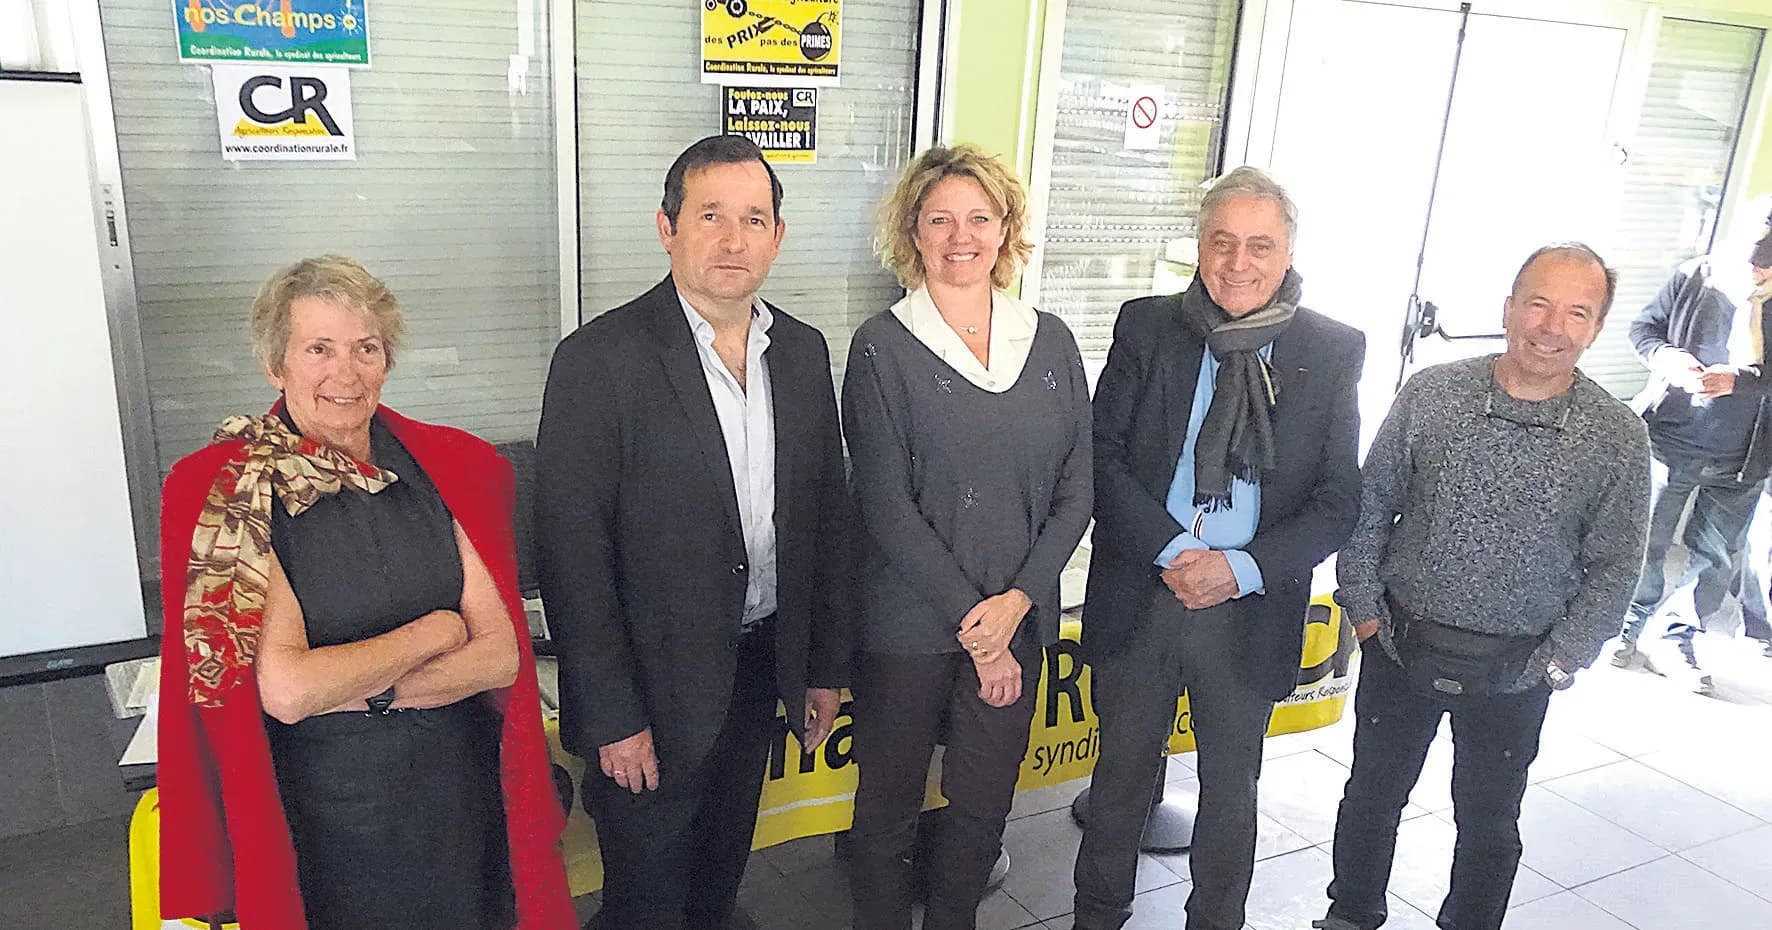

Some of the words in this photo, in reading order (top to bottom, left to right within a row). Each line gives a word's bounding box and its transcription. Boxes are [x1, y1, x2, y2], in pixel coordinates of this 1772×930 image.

[184, 7, 229, 24] nos
[233, 4, 336, 33] Champs
[705, 35, 723, 44] des
[727, 22, 764, 49] PRIX
[760, 38, 778, 47] pas
[780, 36, 798, 47] des
[801, 34, 831, 49] PRIMES
[728, 88, 788, 100] Foutez-nous
[796, 91, 813, 104] CR
[238, 75, 345, 137] CR
[728, 100, 746, 115] LA
[750, 101, 788, 118] PAIX,
[727, 117, 811, 132] Laissez-nous
[225, 143, 348, 154] www.coordinationrurale.fr
[727, 131, 802, 149] VAILLER
[1032, 727, 1099, 777] syndi
